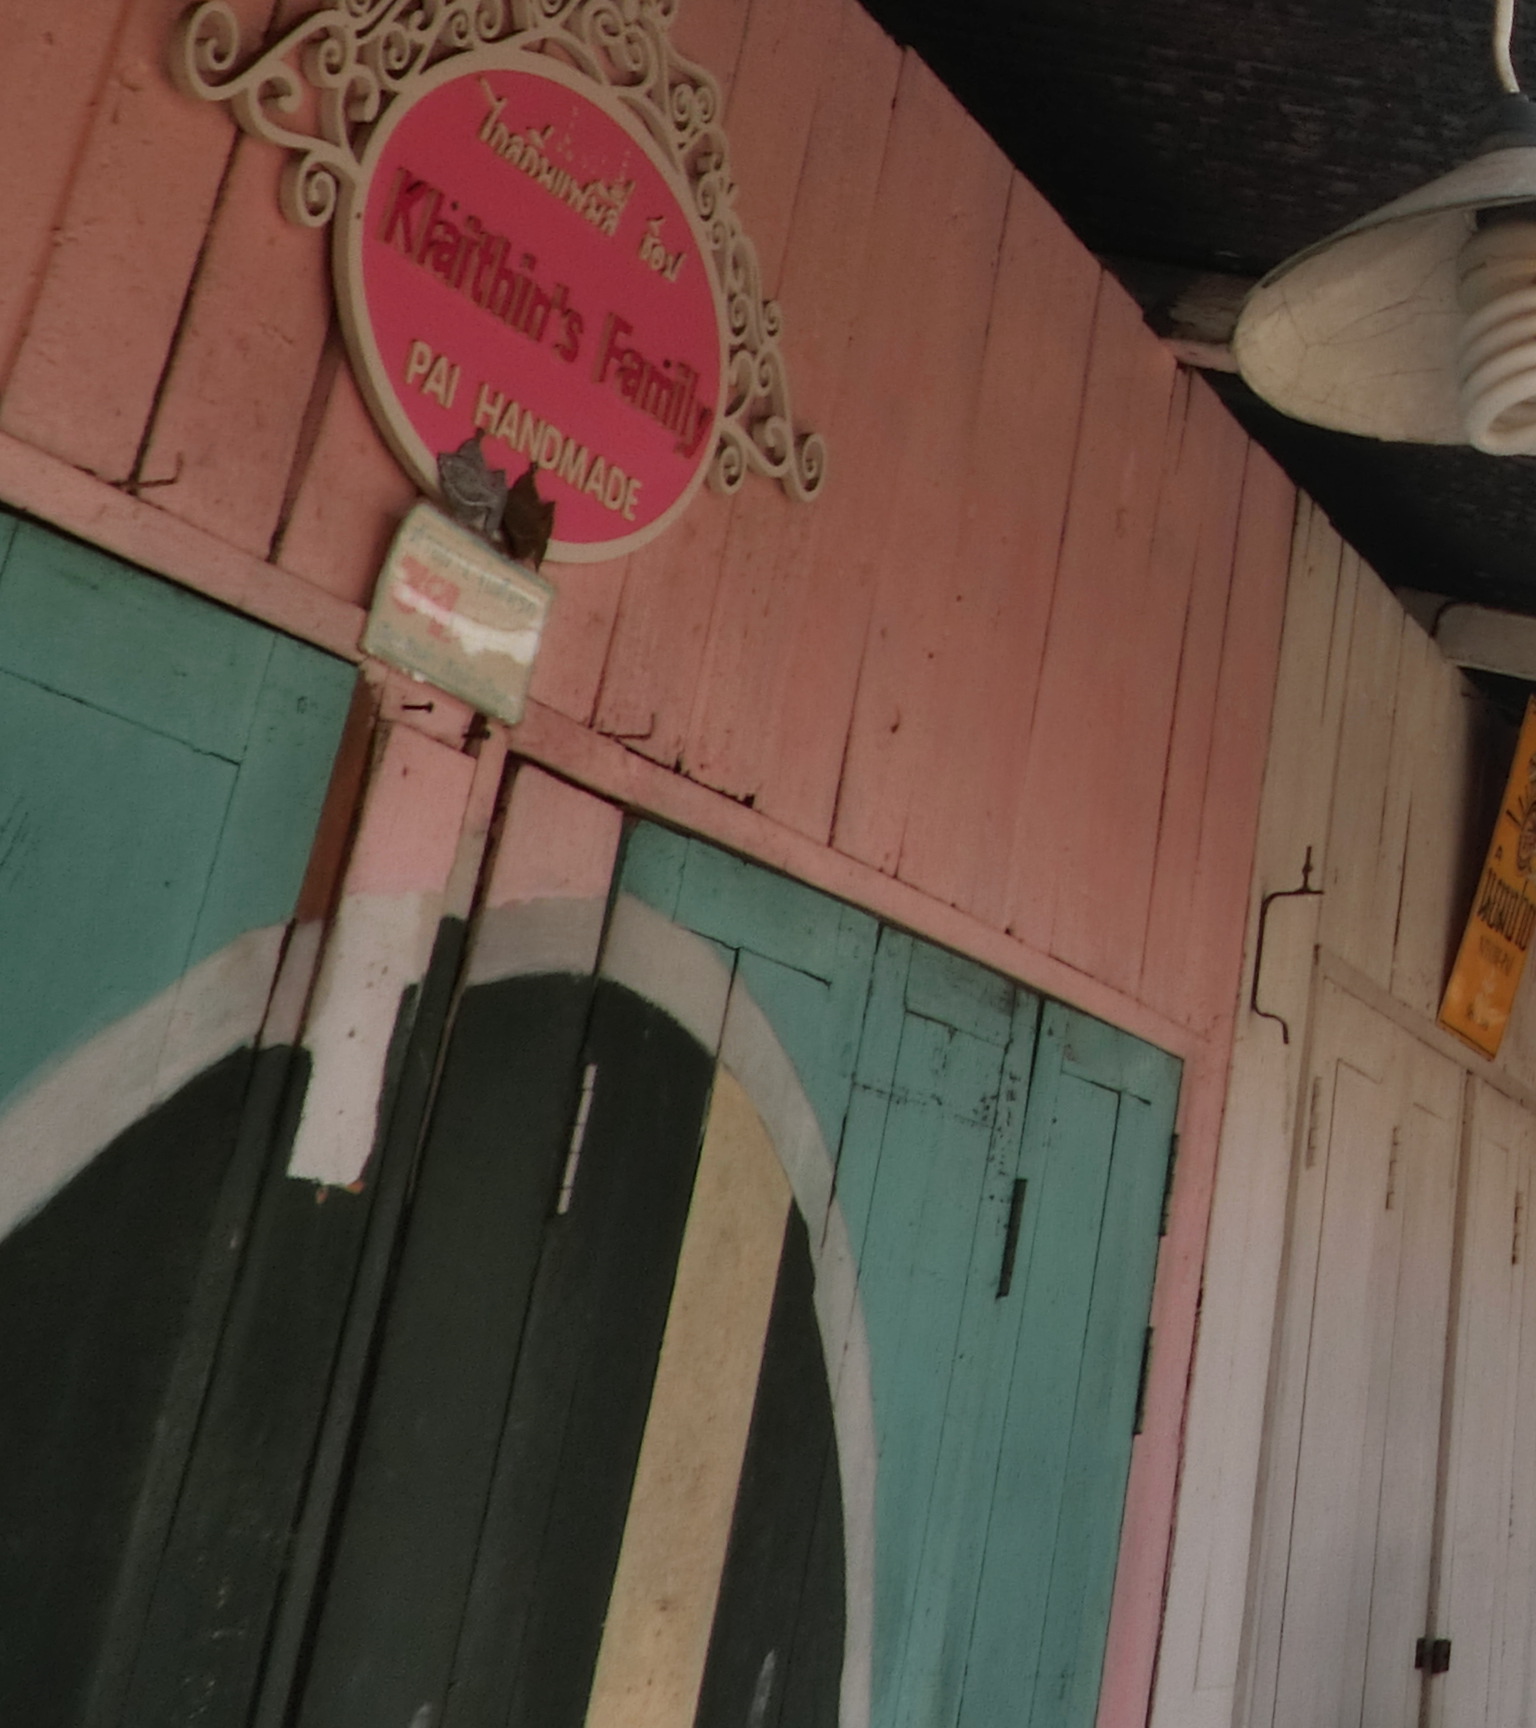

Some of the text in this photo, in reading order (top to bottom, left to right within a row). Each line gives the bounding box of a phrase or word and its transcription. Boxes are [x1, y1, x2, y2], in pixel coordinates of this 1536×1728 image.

[376, 167, 713, 459] Klaithin's Family
[405, 338, 642, 522] PAI HANDMADE
